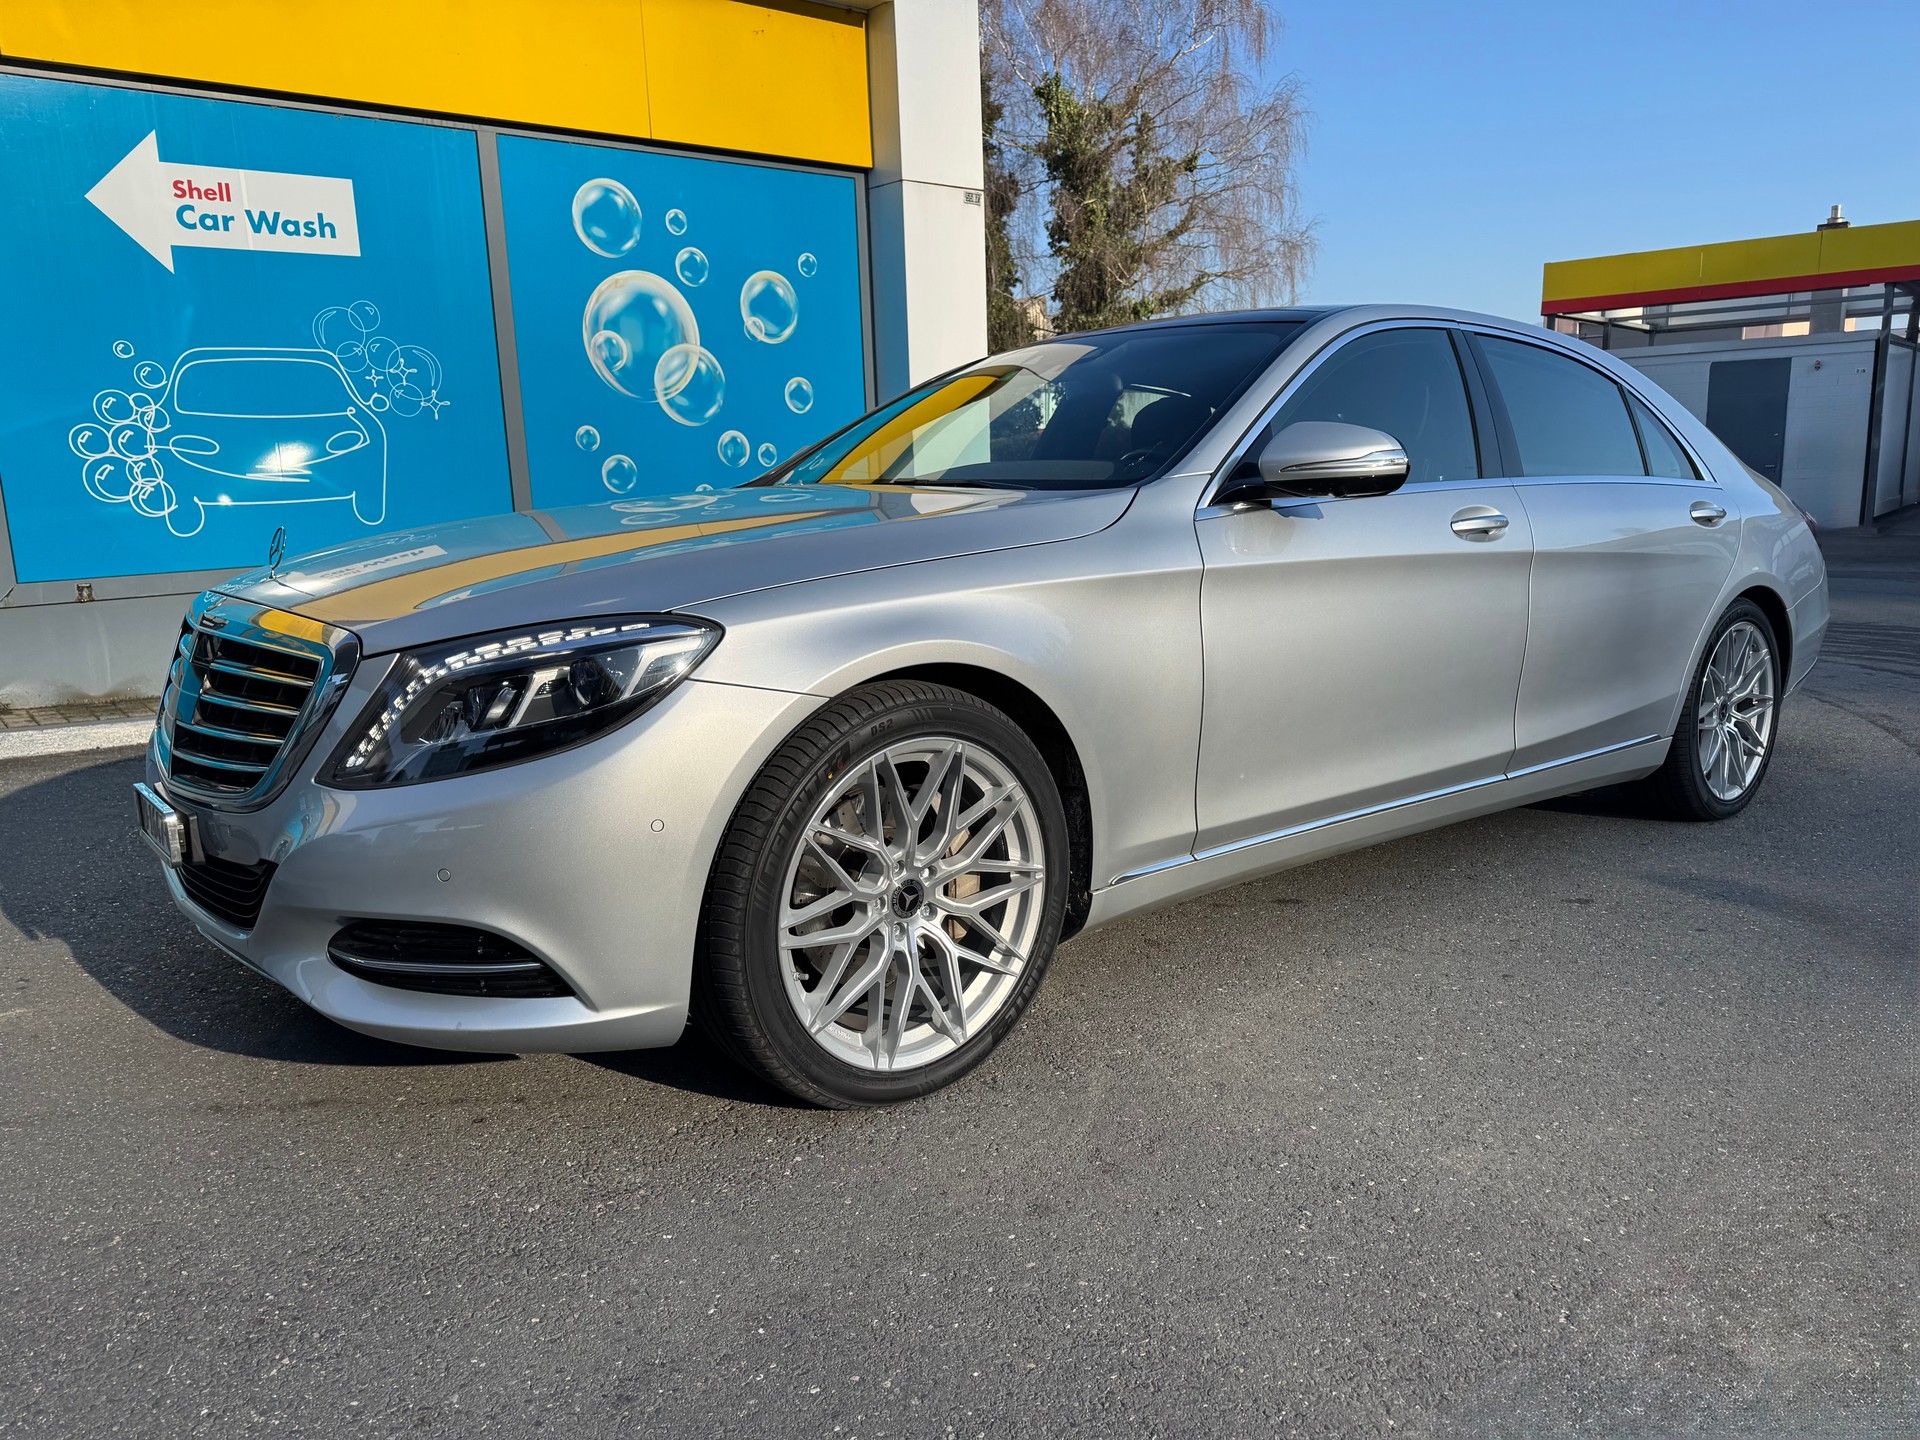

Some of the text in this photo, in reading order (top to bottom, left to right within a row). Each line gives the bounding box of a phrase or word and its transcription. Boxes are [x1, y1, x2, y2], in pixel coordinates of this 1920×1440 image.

[172, 179, 232, 202] Shell
[175, 204, 337, 239] Car Wash
[870, 718, 894, 737] DS2
